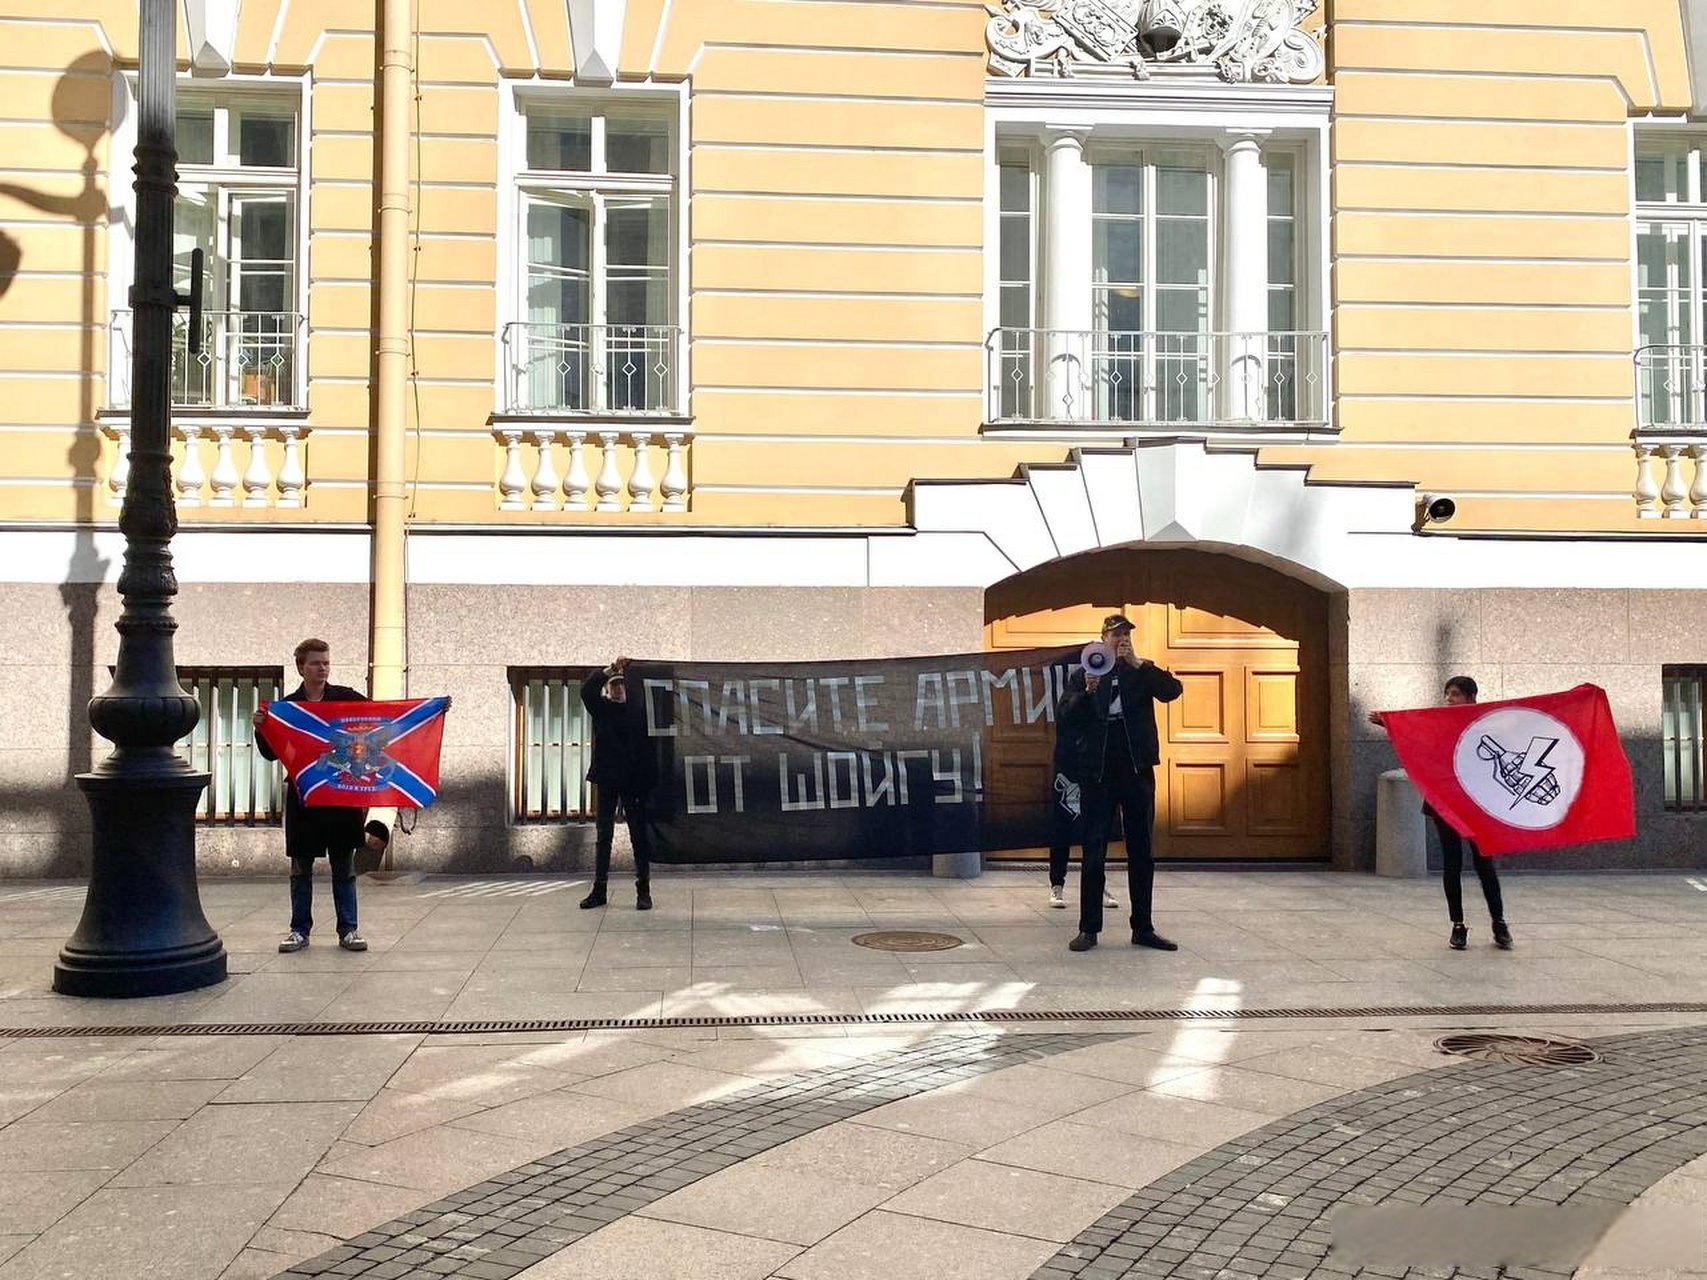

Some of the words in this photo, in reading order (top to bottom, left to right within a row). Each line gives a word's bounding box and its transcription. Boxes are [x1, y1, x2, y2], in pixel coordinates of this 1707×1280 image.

[643, 676, 889, 737] СПАСИТЕ
[684, 754, 751, 814] ОТ
[779, 731, 984, 812] ШОЙГУ!
